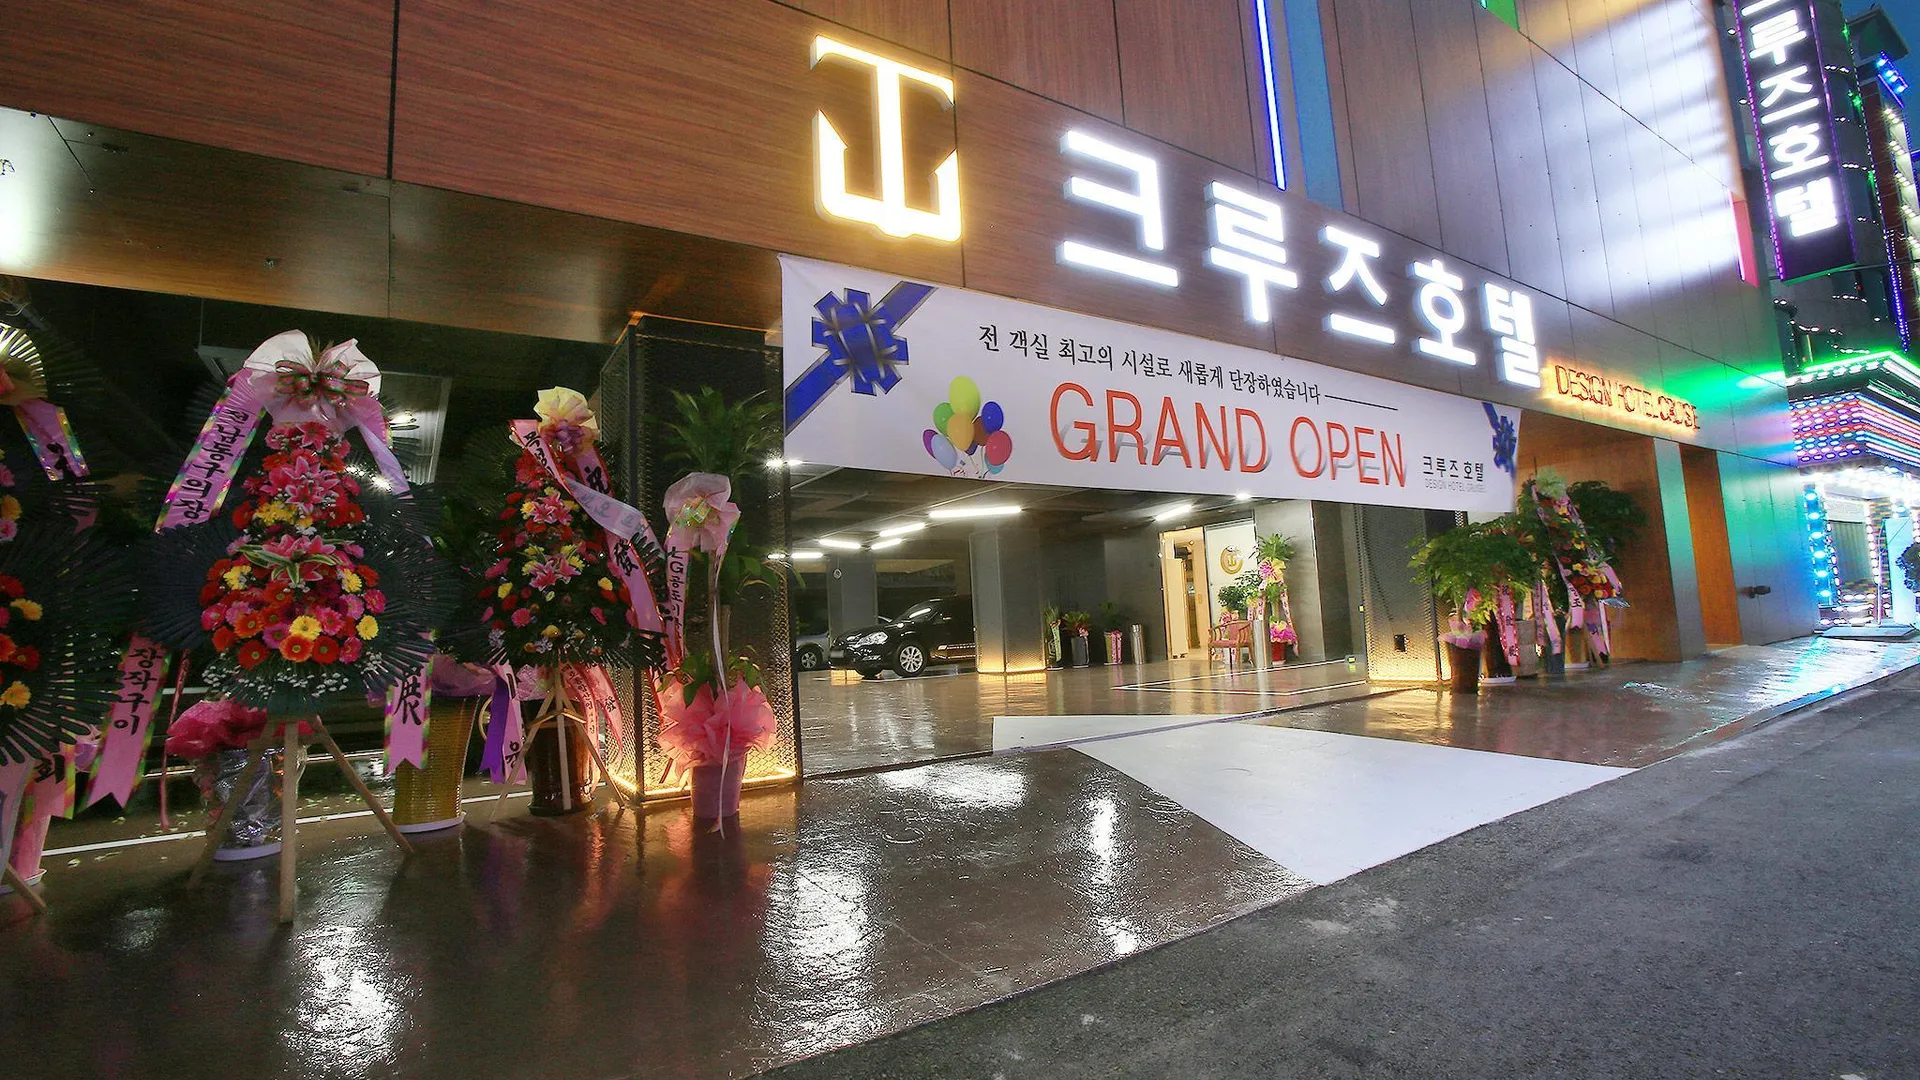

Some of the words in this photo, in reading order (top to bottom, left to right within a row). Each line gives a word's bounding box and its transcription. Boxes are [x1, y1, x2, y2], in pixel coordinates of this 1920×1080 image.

[1057, 130, 1542, 389] 크루즈호텔
[979, 324, 999, 352] 전
[1009, 330, 1050, 360] 객실
[1058, 338, 1113, 371] 최고의
[1122, 350, 1172, 377] 시설로
[1178, 360, 1223, 389] 새롭게
[1229, 369, 1320, 405] 단장하였습니다
[1555, 364, 1612, 406] DESIGN
[1612, 380, 1658, 418] HOTEL
[1050, 382, 1268, 474] GRAND
[1289, 416, 1406, 487] OPEN
